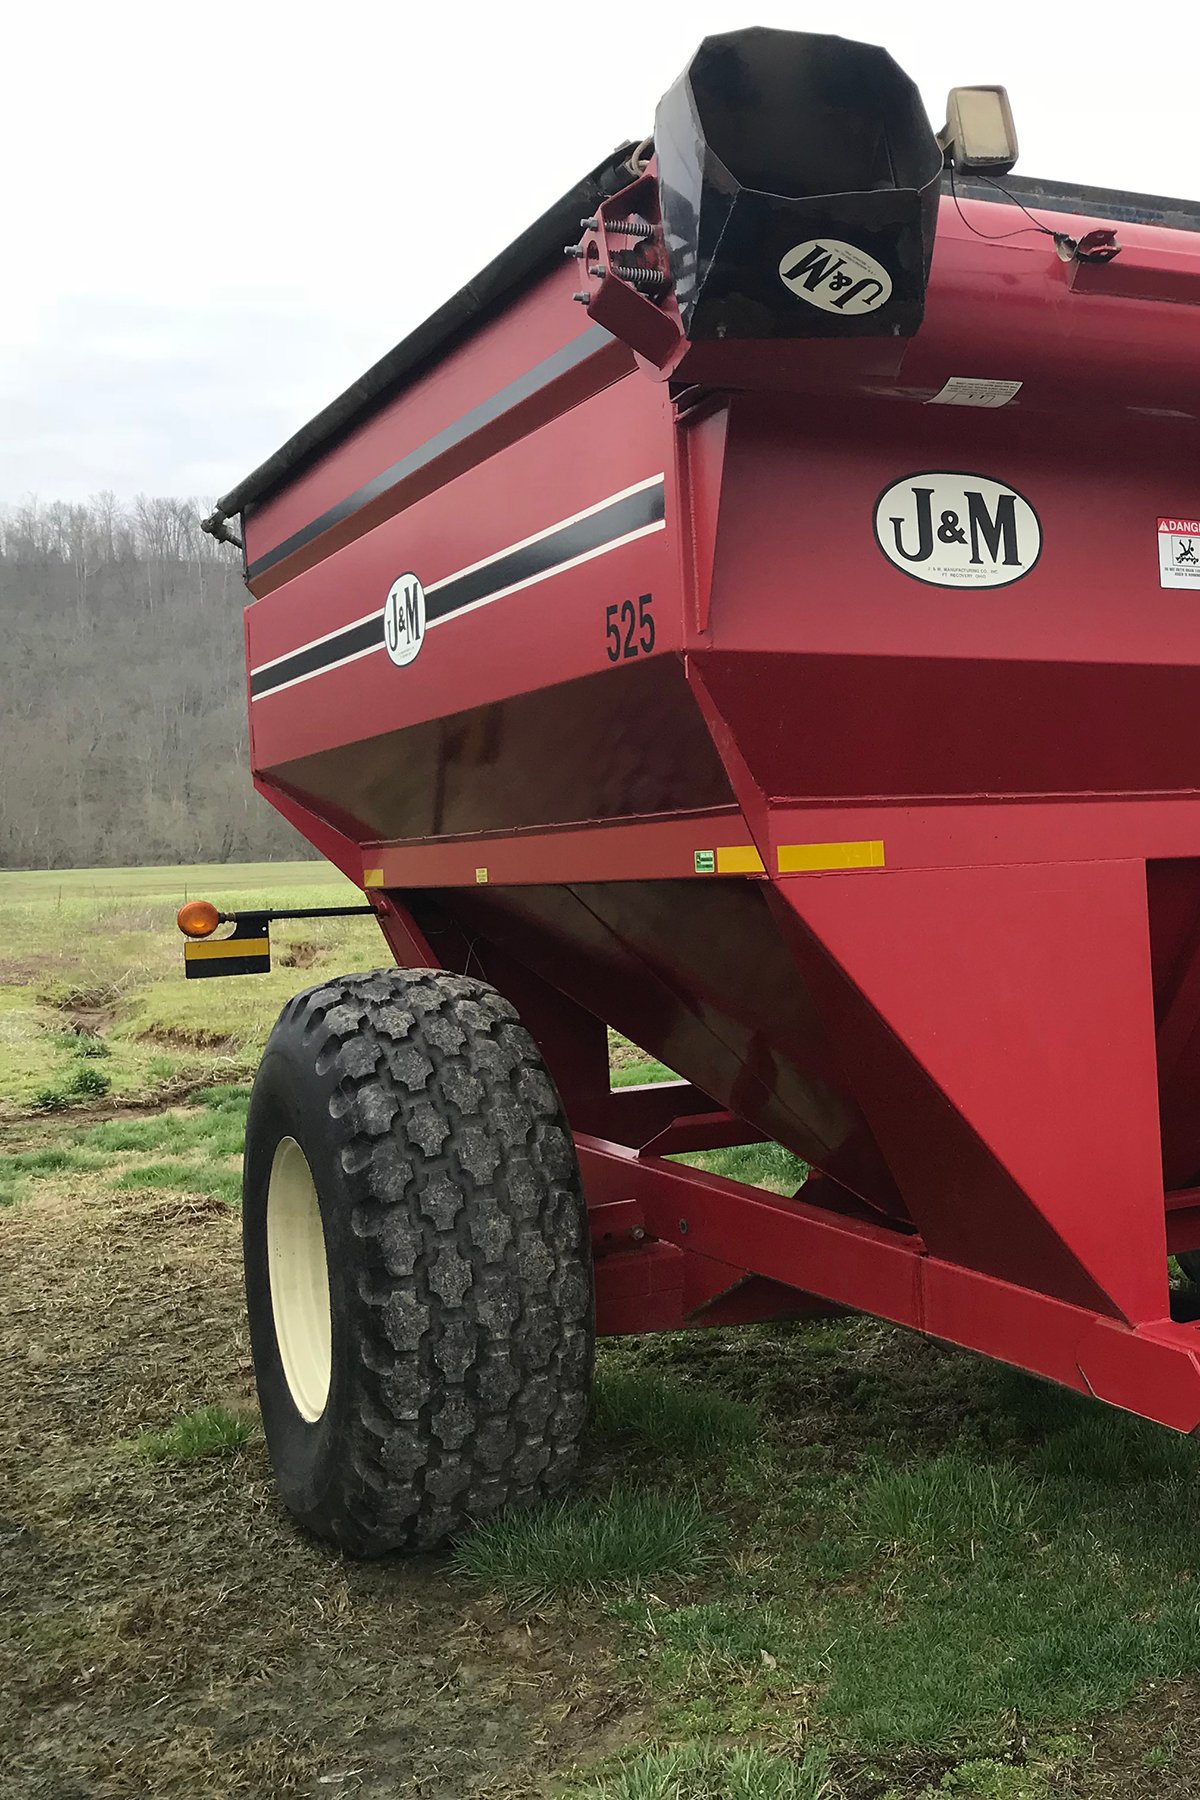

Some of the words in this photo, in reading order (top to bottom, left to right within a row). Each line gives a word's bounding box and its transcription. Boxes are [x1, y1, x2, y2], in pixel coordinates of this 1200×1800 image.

[782, 244, 883, 309] J&M
[889, 488, 1022, 566] J&M
[388, 582, 420, 651] J&M
[606, 593, 655, 662] 525
